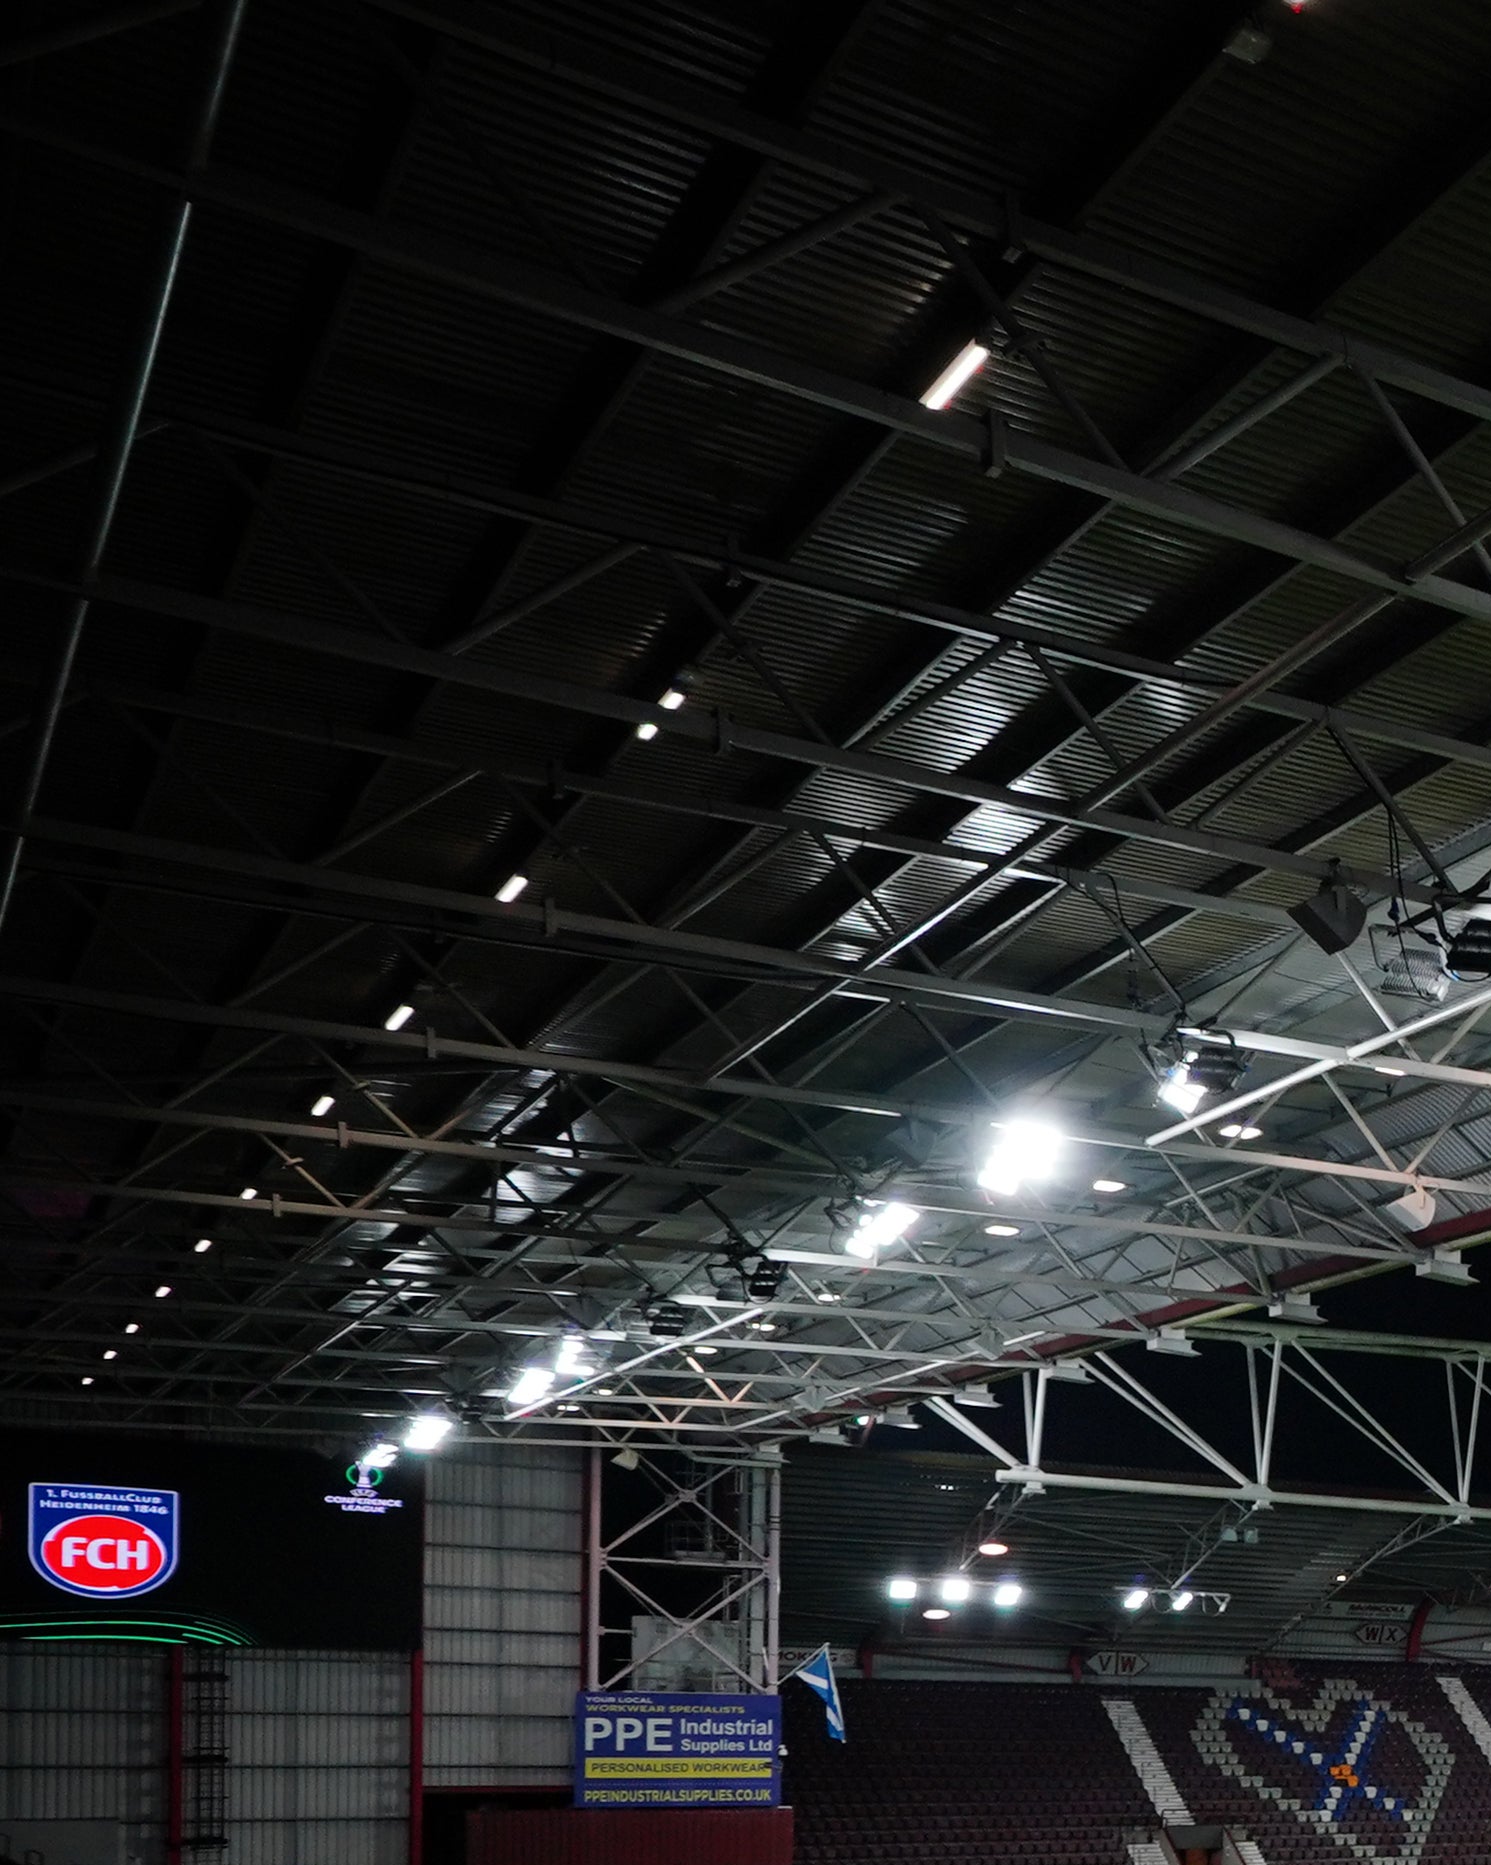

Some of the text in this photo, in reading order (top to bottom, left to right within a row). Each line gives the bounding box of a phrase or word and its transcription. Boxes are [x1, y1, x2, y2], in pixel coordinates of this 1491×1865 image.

[134, 1504, 169, 1515] 1846
[61, 1536, 149, 1571] FCH
[1385, 1626, 1398, 1642] X
[1098, 1655, 1112, 1672] V
[585, 1696, 616, 1704] YOUR
[586, 1704, 746, 1714] WORKWEAR SPECIALISTS
[584, 1717, 674, 1752] PPE
[680, 1718, 773, 1736] Industrial
[680, 1739, 773, 1754] Supplies Ltd
[591, 1763, 767, 1774] PERSONALISED WORKWEAR
[584, 1788, 772, 1804] PPEINDUSTRIALSUPPLIES.CO.UK
